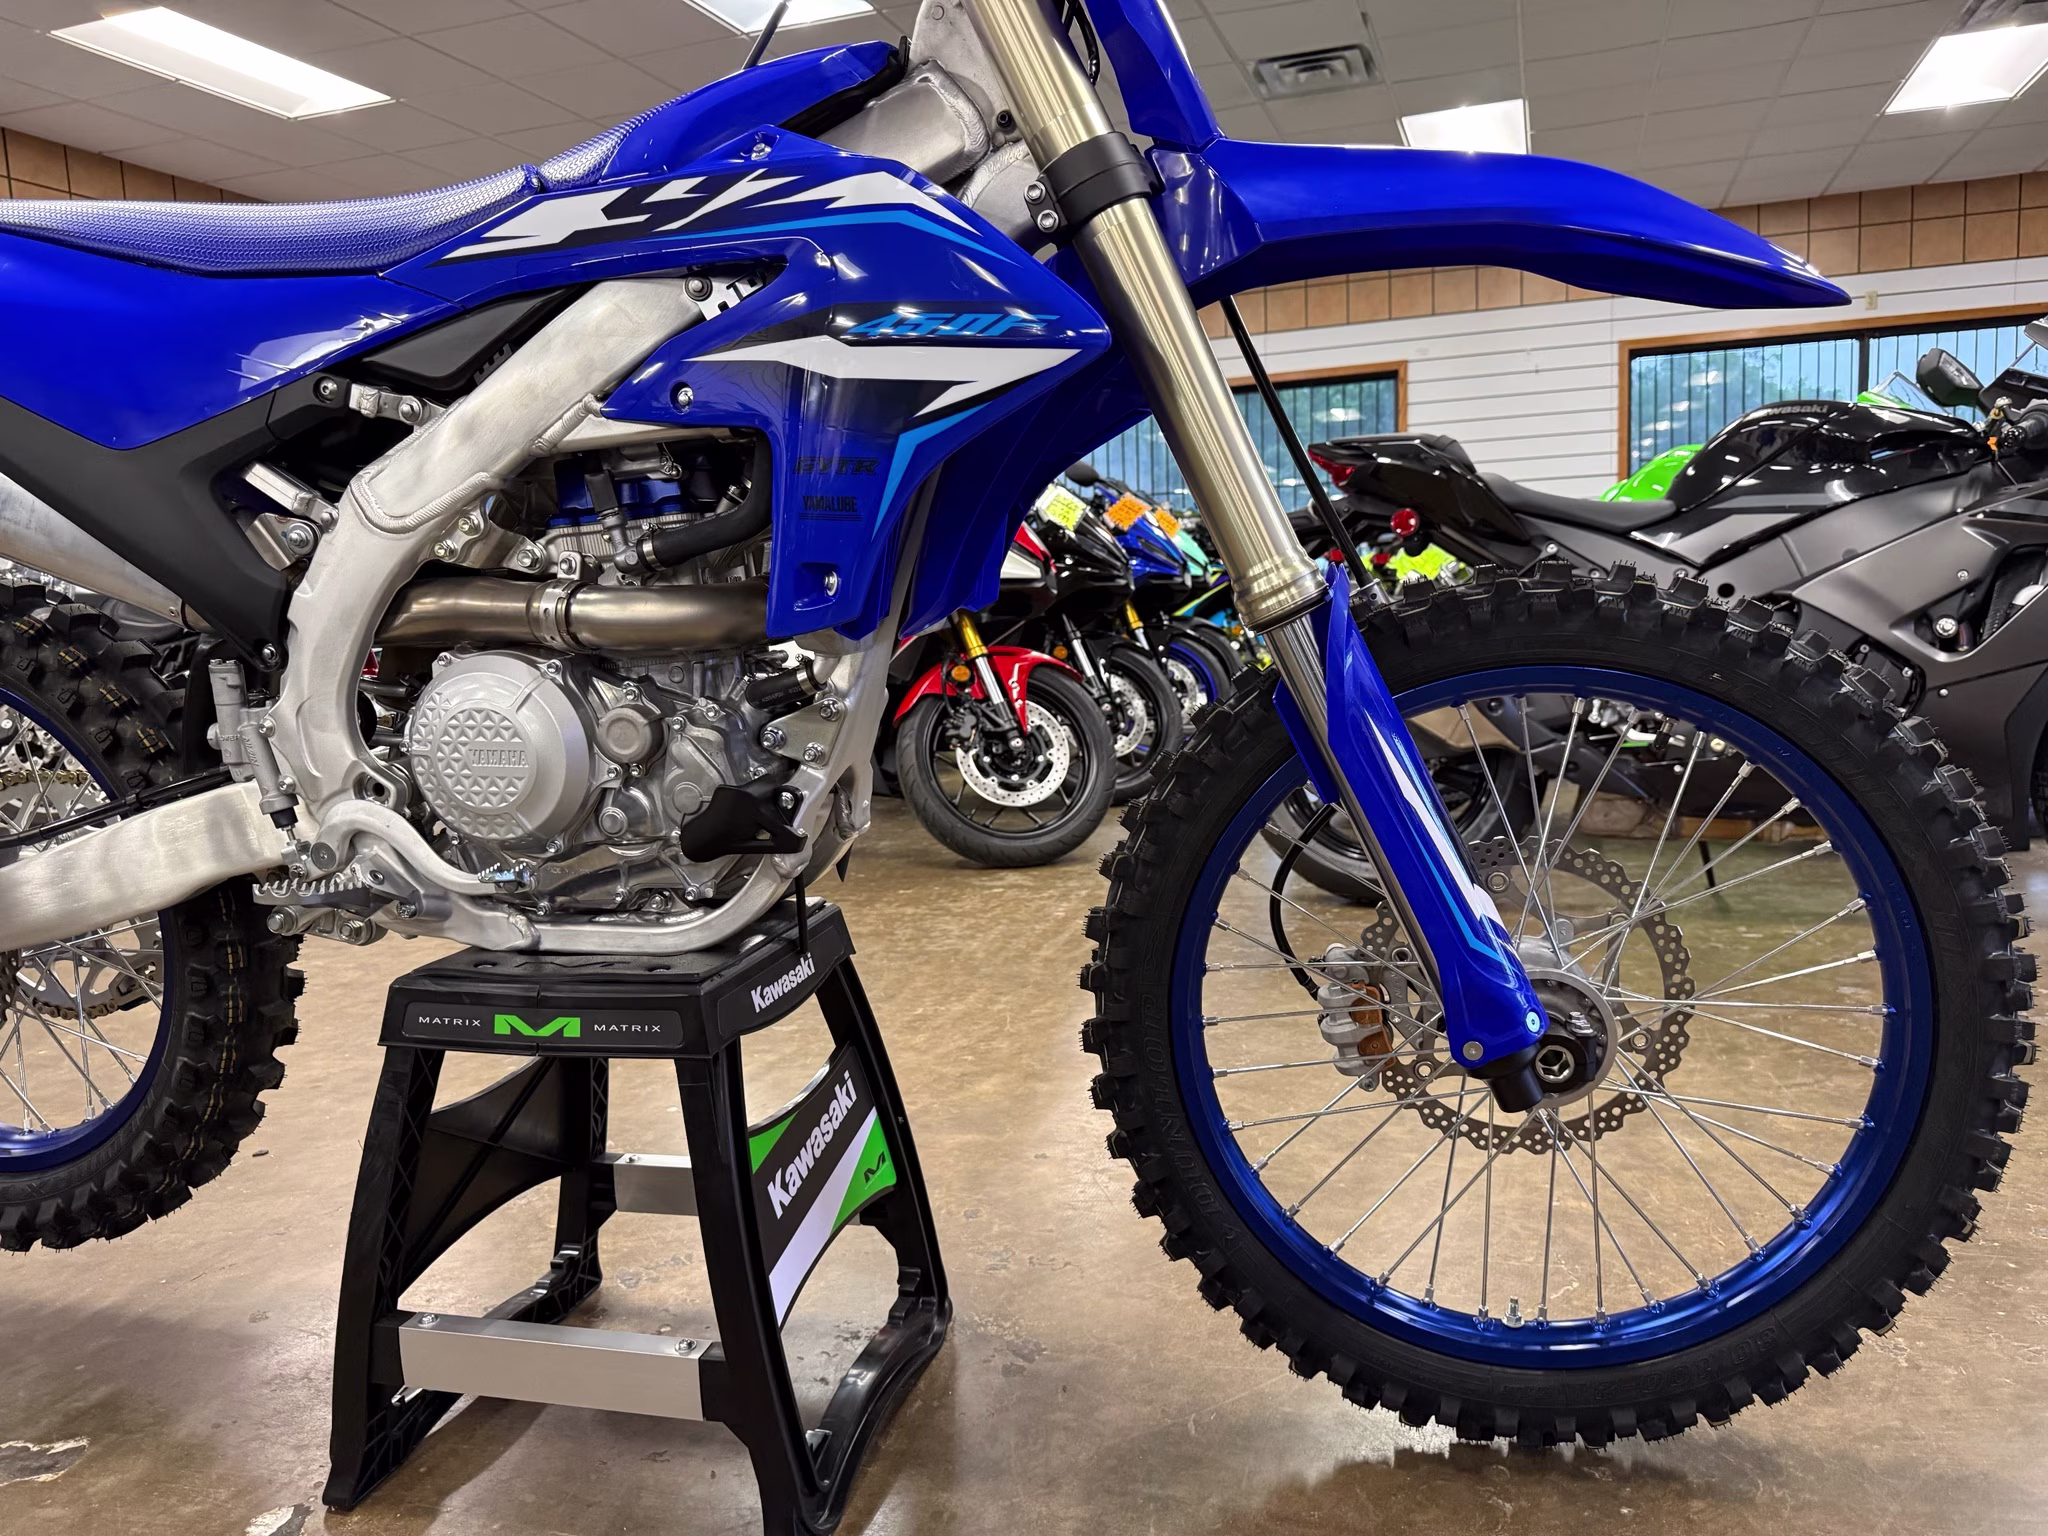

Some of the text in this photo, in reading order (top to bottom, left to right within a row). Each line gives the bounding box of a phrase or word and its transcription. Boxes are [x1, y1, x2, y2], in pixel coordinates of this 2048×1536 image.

[848, 312, 1061, 337] 450F
[1760, 404, 1829, 416] wasaki
[468, 749, 529, 768] YAMAHA
[750, 952, 816, 1013] Kawasaki
[418, 1015, 482, 1027] MATRIX
[594, 1023, 662, 1033] MATRIX
[767, 1069, 857, 1220] Kawasaki
